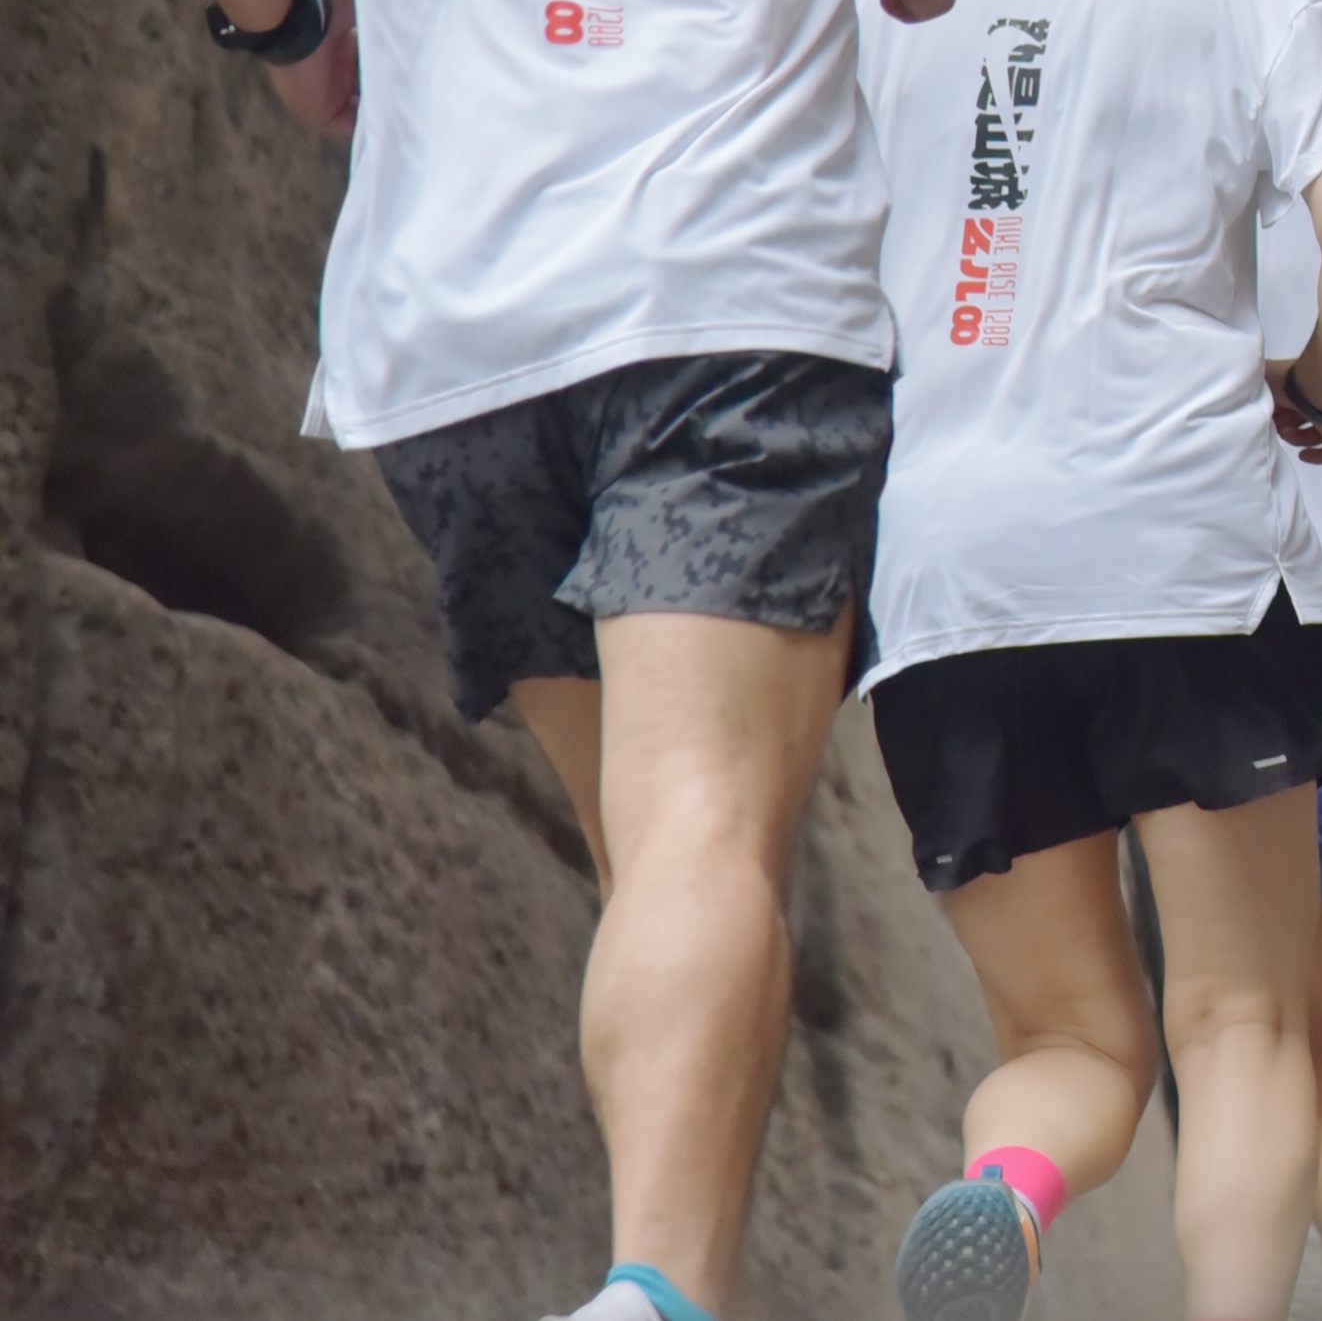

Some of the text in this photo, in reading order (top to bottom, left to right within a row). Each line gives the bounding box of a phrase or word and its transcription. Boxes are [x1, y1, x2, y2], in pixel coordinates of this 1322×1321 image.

[588, 3, 625, 48] 1200
[981, 215, 1023, 347] NIKE RISE 1200
